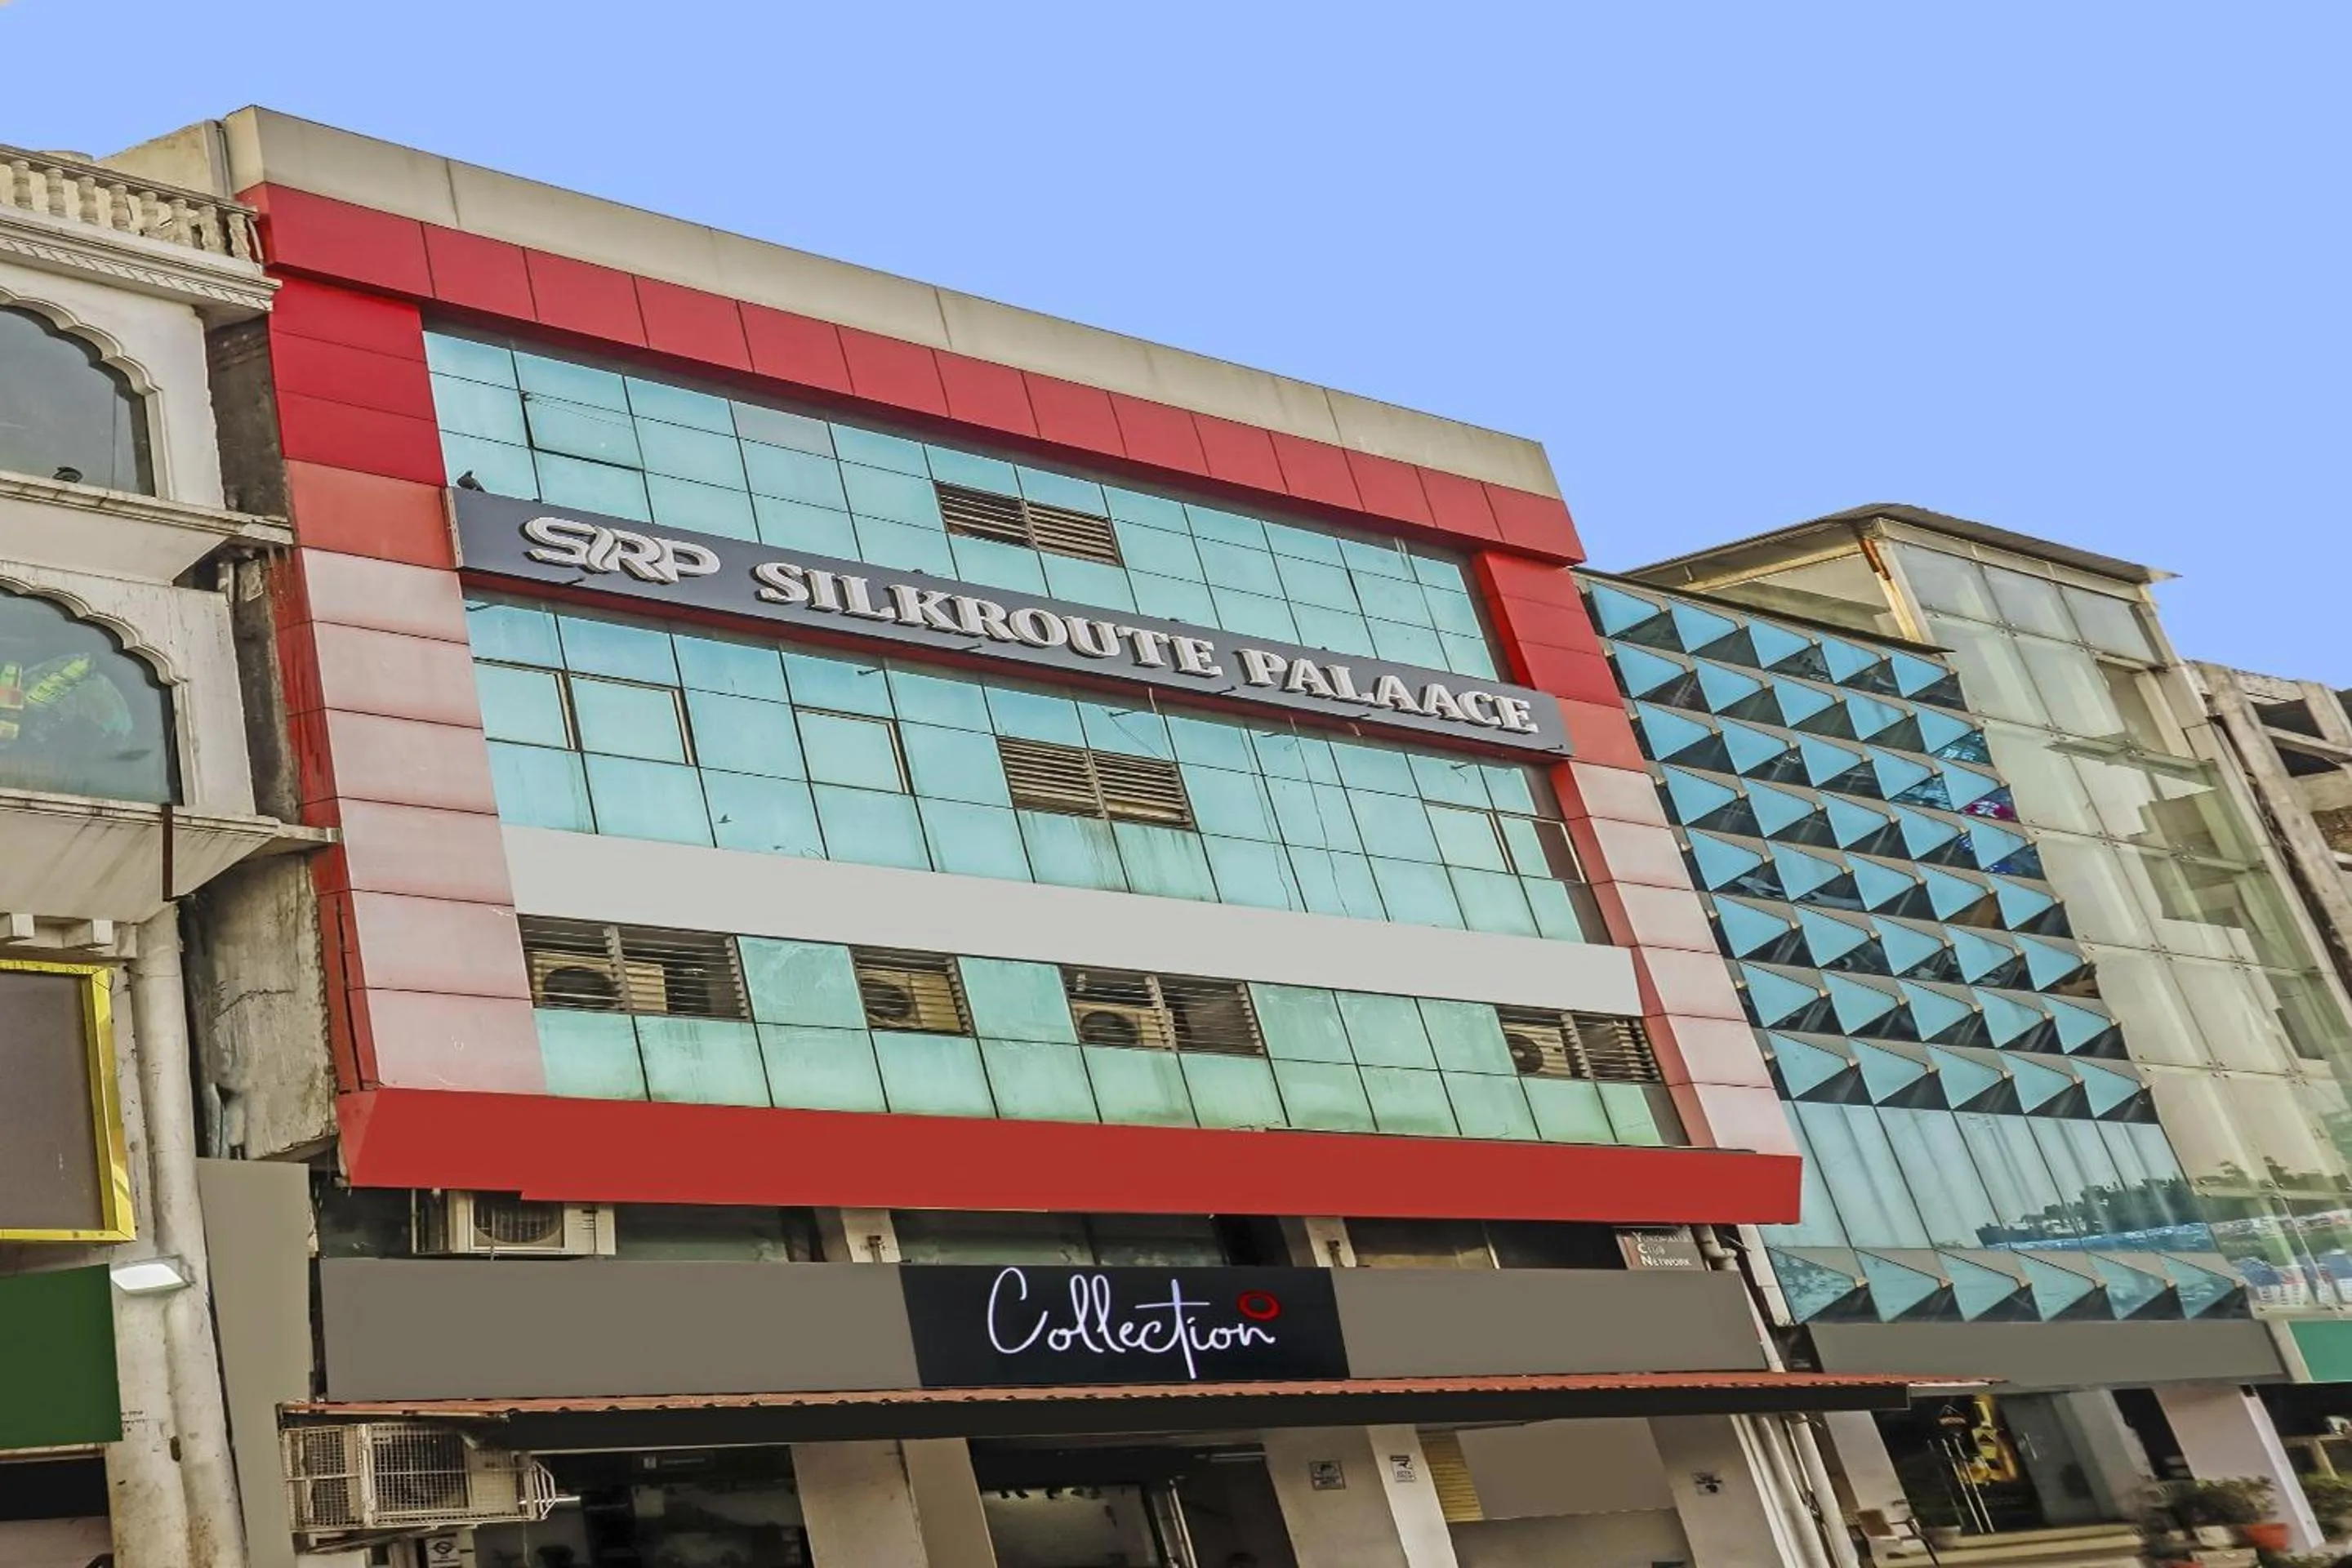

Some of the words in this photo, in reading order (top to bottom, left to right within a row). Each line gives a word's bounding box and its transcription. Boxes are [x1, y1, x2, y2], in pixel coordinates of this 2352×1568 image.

[523, 516, 721, 583] SRP
[754, 561, 1223, 677] SILKROUTE
[1238, 648, 1540, 733] PALAACE
[987, 1267, 1276, 1379] Collection
